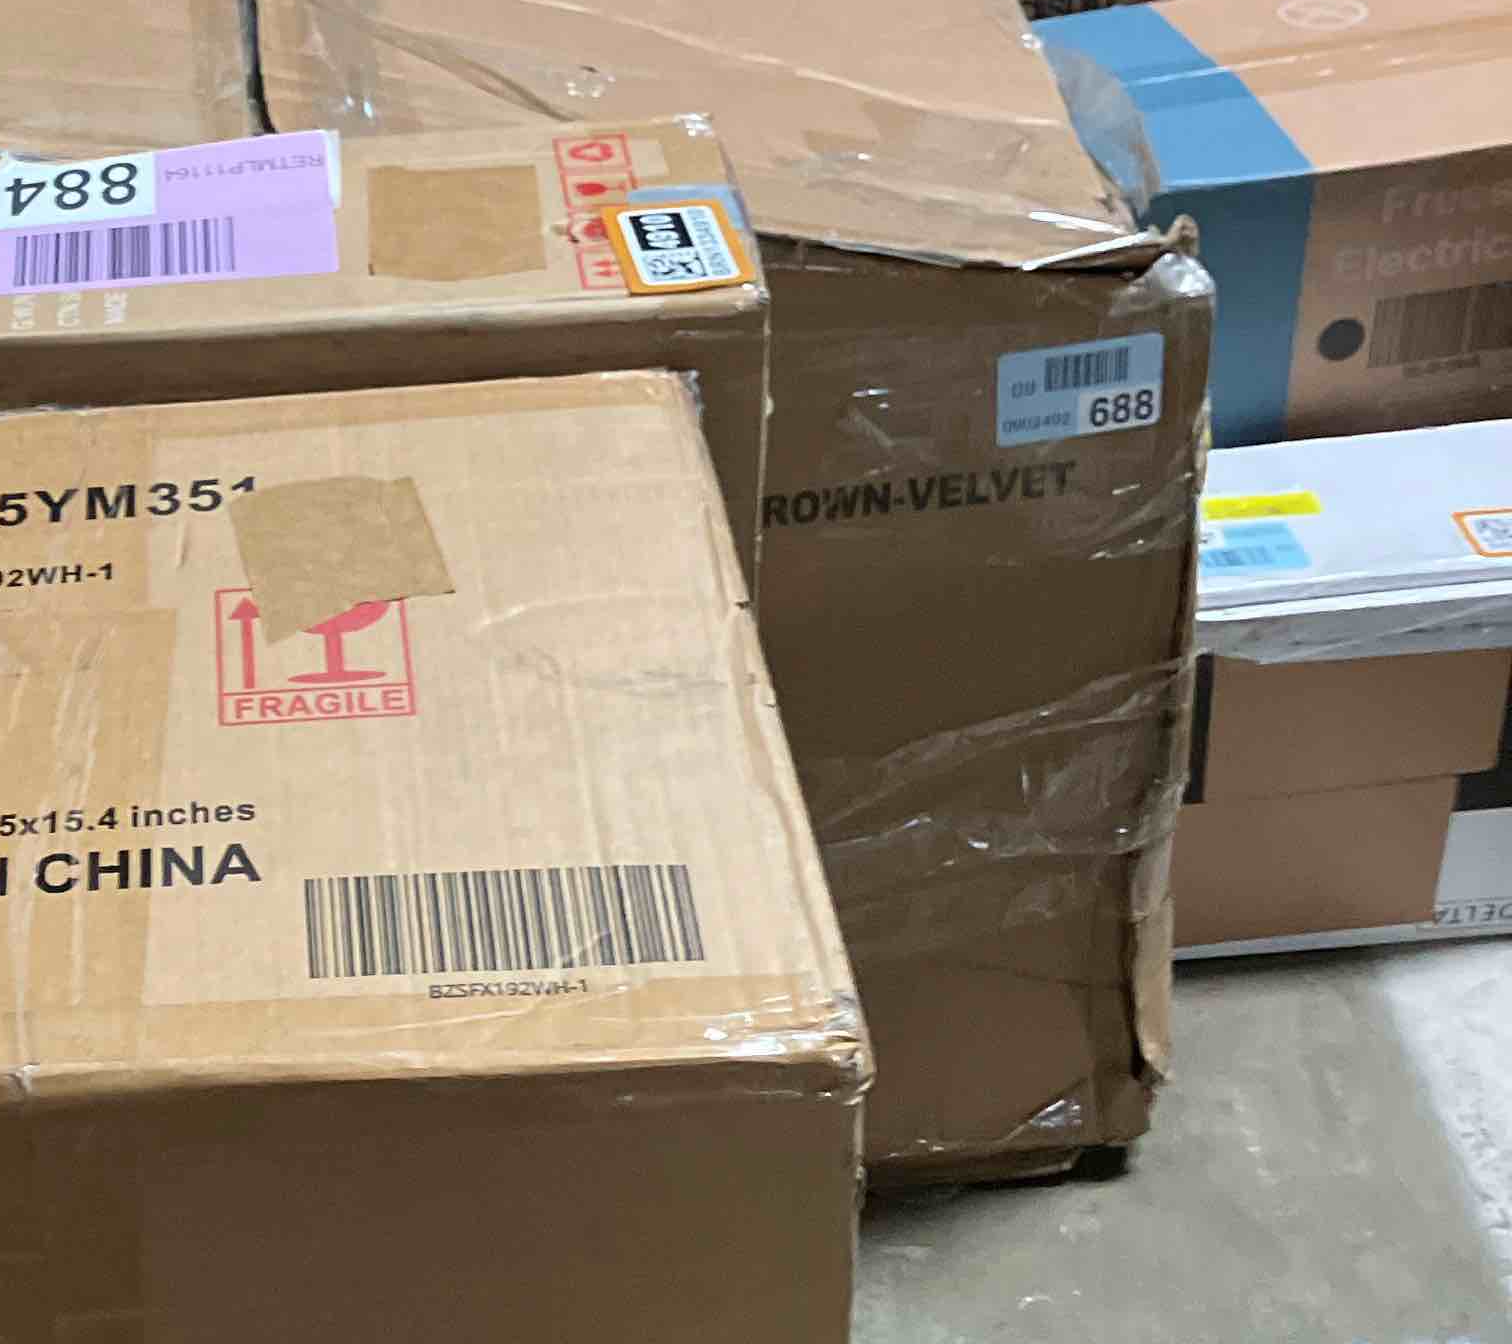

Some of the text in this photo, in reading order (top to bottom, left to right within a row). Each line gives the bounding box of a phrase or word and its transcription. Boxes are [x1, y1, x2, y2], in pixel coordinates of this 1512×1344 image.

[4, 162, 138, 217] 884
[639, 213, 681, 248] 4910
[1088, 389, 1154, 429] 688
[761, 459, 1077, 529] ROWN-VELVET
[232, 688, 409, 720] FRAGILE
[130, 799, 257, 829] inches
[33, 842, 262, 897] CHINA
